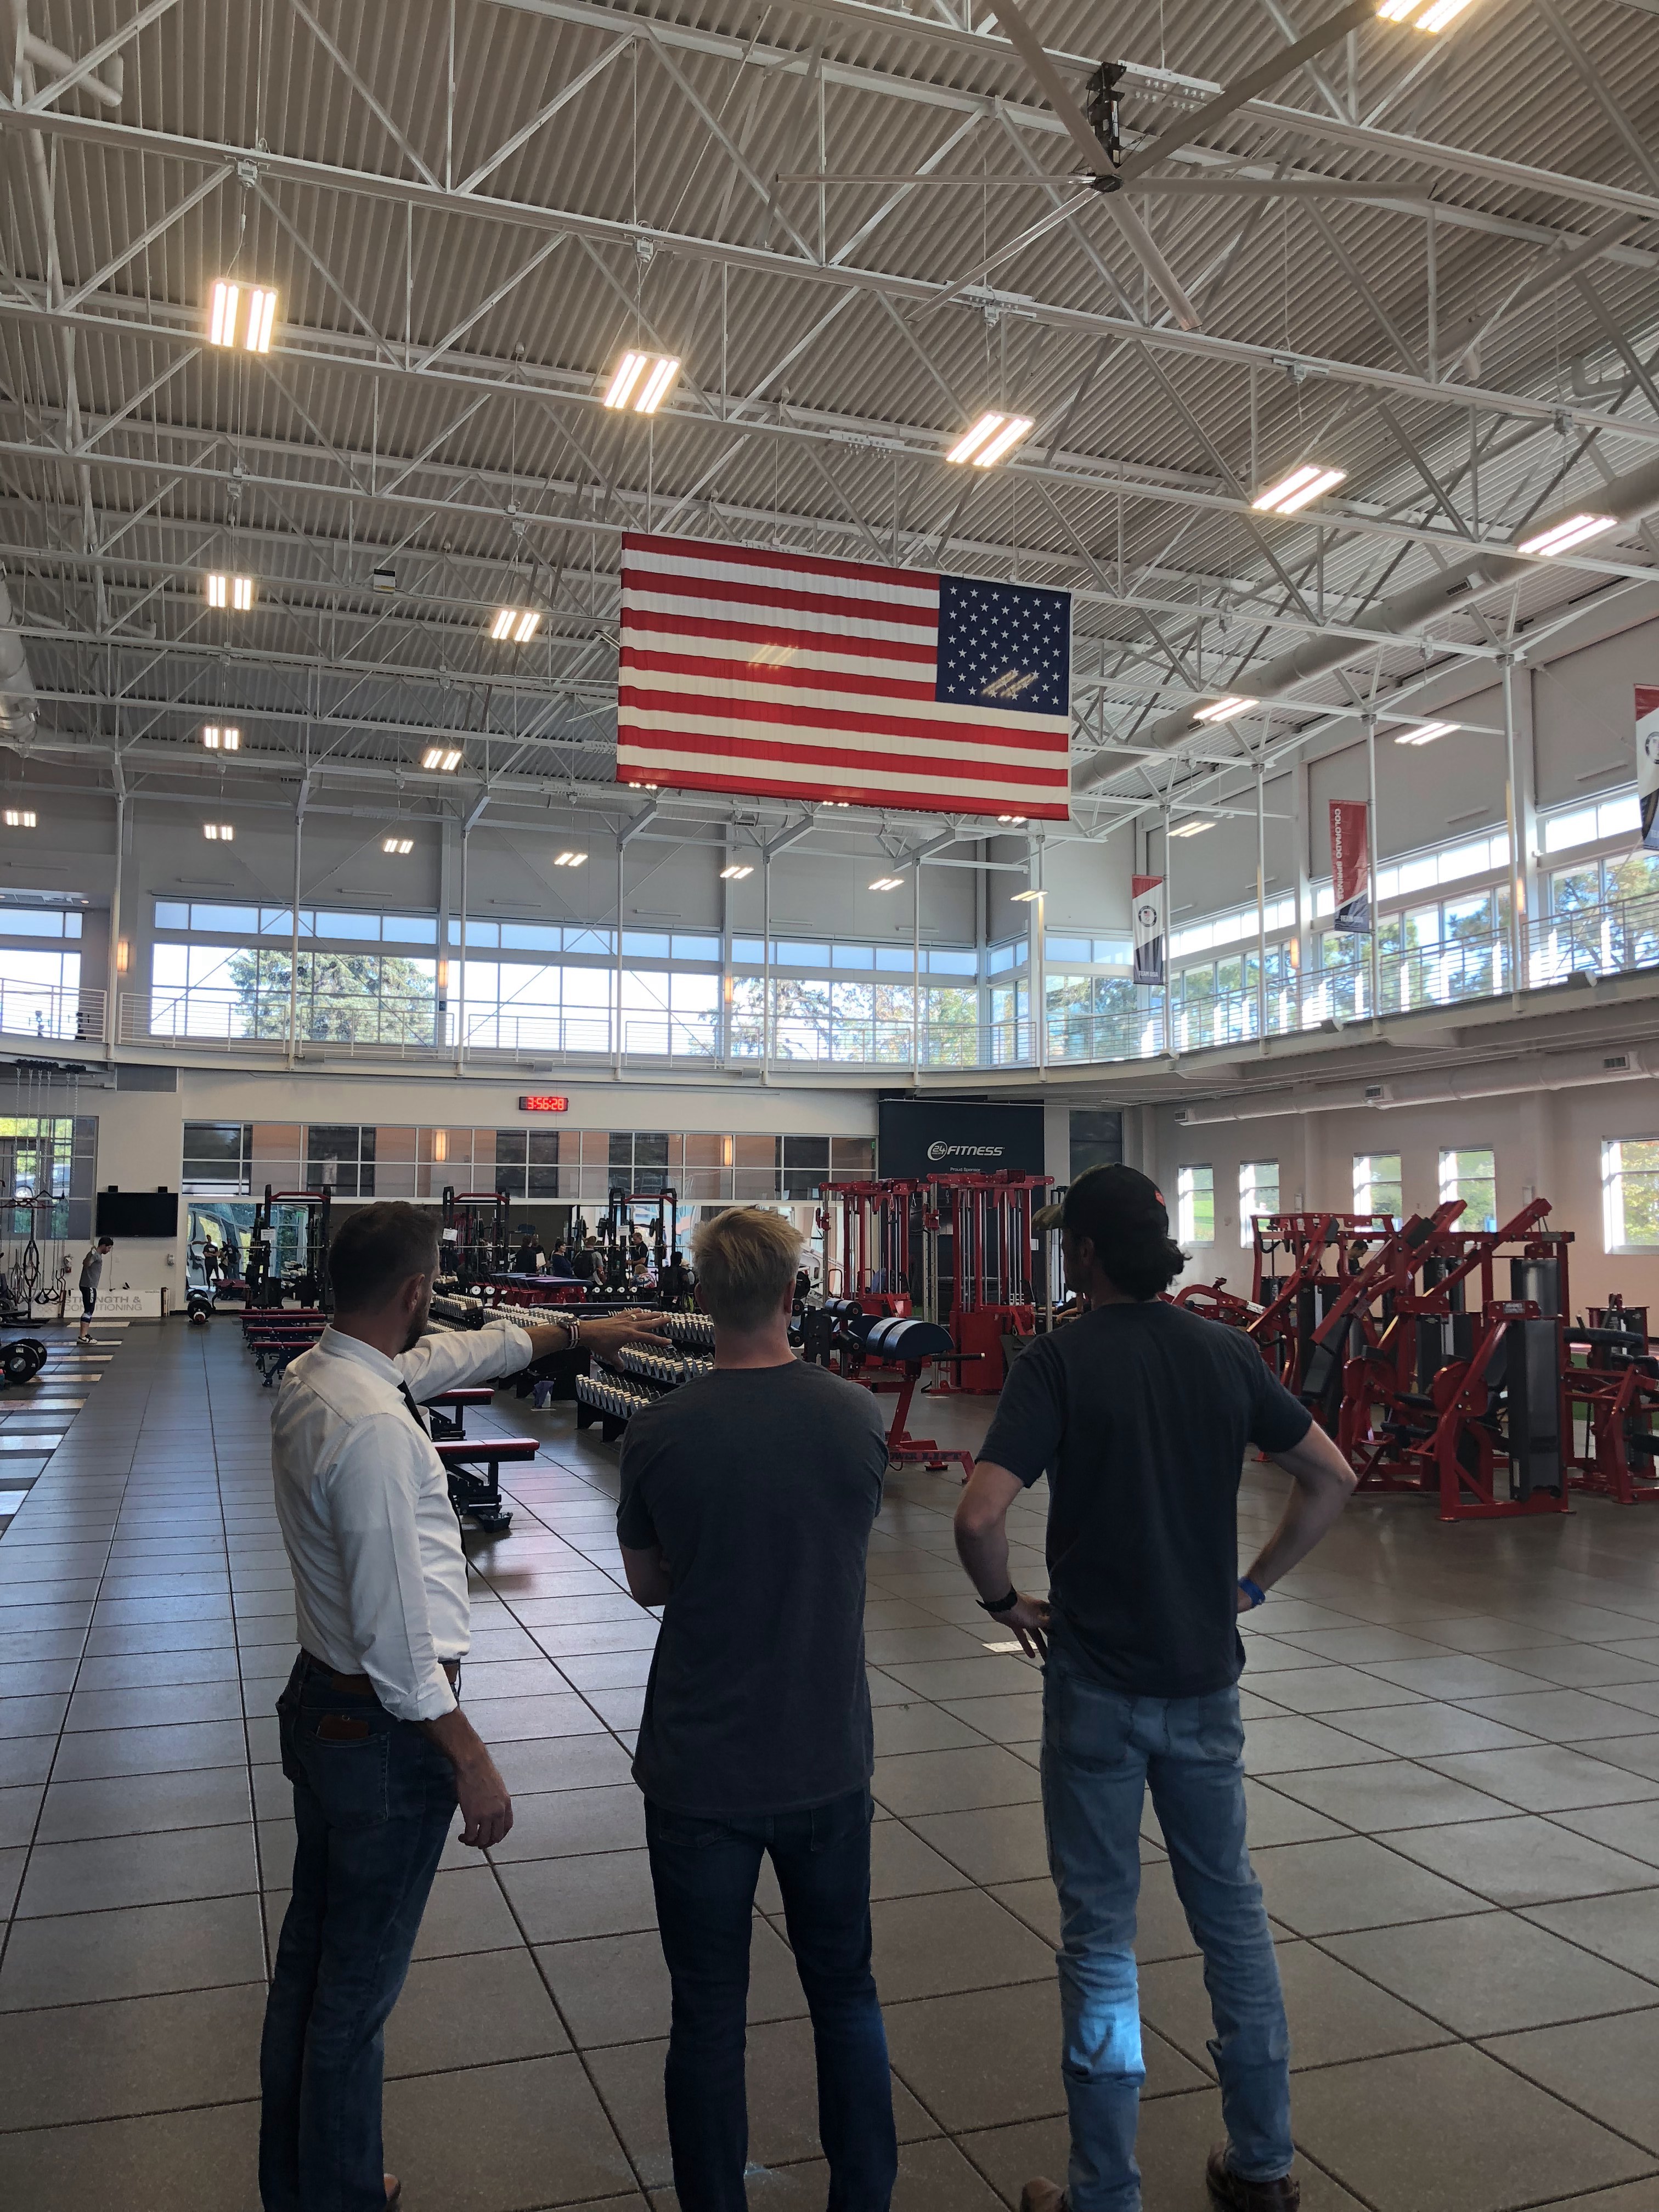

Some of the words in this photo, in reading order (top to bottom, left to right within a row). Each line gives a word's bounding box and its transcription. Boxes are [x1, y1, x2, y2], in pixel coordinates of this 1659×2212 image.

[1335, 808, 1343, 859] COLORADO
[1336, 861, 1344, 900] SPRINGS
[527, 1097, 564, 1110] 3:56:28
[933, 1146, 946, 1155] 24
[947, 1146, 1003, 1156] FITNESS
